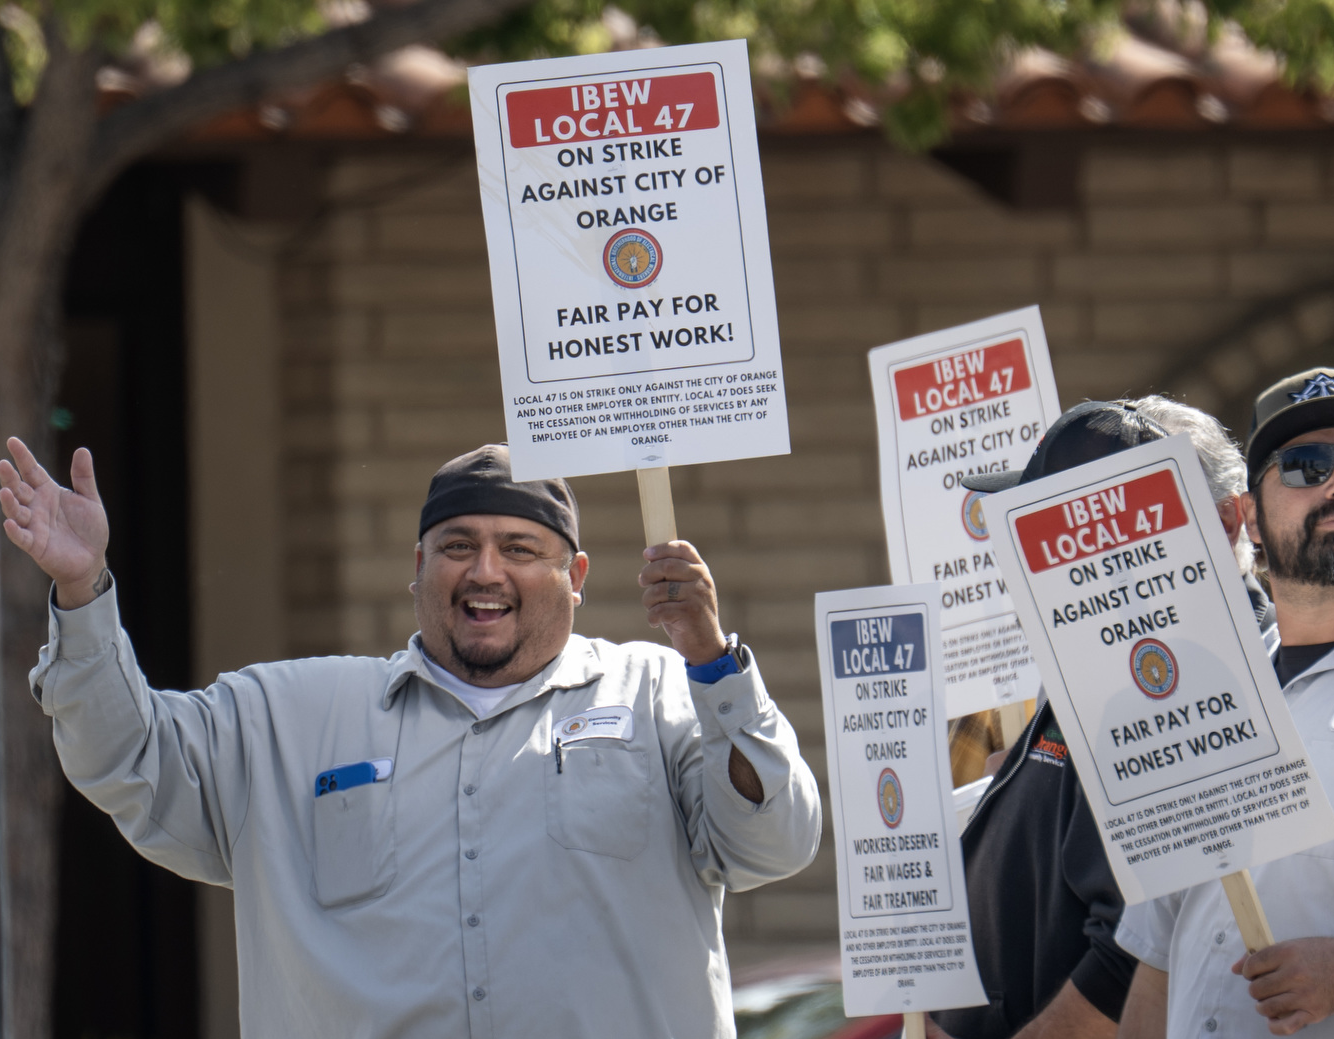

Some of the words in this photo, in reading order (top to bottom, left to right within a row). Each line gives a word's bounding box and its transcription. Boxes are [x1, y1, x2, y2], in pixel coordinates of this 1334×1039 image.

[571, 79, 651, 111] IBEW
[534, 109, 642, 142] LOCAL
[653, 102, 694, 129] 47
[557, 146, 593, 167] ON
[602, 137, 682, 163] STRIKE
[521, 175, 626, 203] AGAINST
[634, 168, 686, 191] CITY
[694, 164, 725, 185] OF
[576, 201, 677, 229] ORANGE
[557, 304, 610, 327] FAIR
[617, 298, 663, 321] PAY
[672, 293, 720, 315] FOR
[548, 332, 642, 360] HONEST
[649, 322, 734, 349] WORK!
[933, 348, 984, 384] IBEW
[513, 394, 544, 406] LOCAL
[545, 393, 557, 402] 47
[558, 391, 568, 401] IS
[569, 390, 584, 400] ON
[585, 387, 616, 398] STRIKE
[618, 384, 642, 395] ONLY
[644, 380, 684, 392] AGAINST
[685, 378, 702, 388] THE
[703, 375, 723, 386] CITY
[725, 374, 738, 384] OF
[740, 370, 777, 382] ORANGE
[516, 408, 537, 419] AND
[538, 406, 553, 416] NO
[554, 403, 584, 414] OTHER
[585, 398, 633, 411] EMPLOYER
[634, 396, 649, 406] OR
[650, 393, 683, 405] ENTITY.
[684, 390, 714, 401] LOCAL
[716, 388, 728, 397] 47
[729, 385, 754, 396] DOES
[755, 383, 777, 394] SEEK
[913, 377, 984, 415] LOCAL
[989, 367, 1013, 394] 47
[930, 414, 954, 435] ON
[959, 400, 1010, 429] STRIKE
[631, 433, 672, 446] ORANGE.
[907, 438, 975, 471] AGAINST
[981, 428, 1014, 452] CITY
[1019, 422, 1039, 442] OF
[1062, 485, 1126, 528] IBEW
[1041, 518, 1129, 565] LOCAL
[1135, 503, 1163, 534] 47
[934, 558, 969, 581] FAIR
[973, 550, 995, 573] PA
[1069, 562, 1098, 586] ON
[1101, 540, 1167, 576] STRIKE
[942, 582, 992, 608] ONEST
[1053, 585, 1130, 628] AGAINST
[1135, 570, 1175, 600] CITY
[1182, 561, 1206, 584] OF
[856, 617, 892, 645] IBEW
[1100, 605, 1179, 646] ORANGE
[842, 646, 889, 674] LOCAL
[894, 643, 914, 669] 47
[855, 682, 870, 701] ON
[872, 678, 907, 699] STRIKE
[843, 711, 883, 732] AGAINST
[886, 709, 910, 729] CITY
[912, 707, 927, 726] OF
[1110, 719, 1153, 747] FAIR
[1154, 705, 1190, 733] PAY
[1195, 692, 1237, 719] FOR
[865, 740, 907, 761] ORANGE
[1113, 742, 1183, 781] HONEST
[1186, 718, 1258, 757] WORK!
[853, 836, 897, 855] WORKERS
[898, 832, 939, 851] DESERVE
[864, 865, 884, 882] FAIR
[885, 861, 922, 881] WAGES
[924, 860, 933, 878] &
[863, 893, 883, 910] FAIR
[884, 889, 938, 908] TREATMENT
